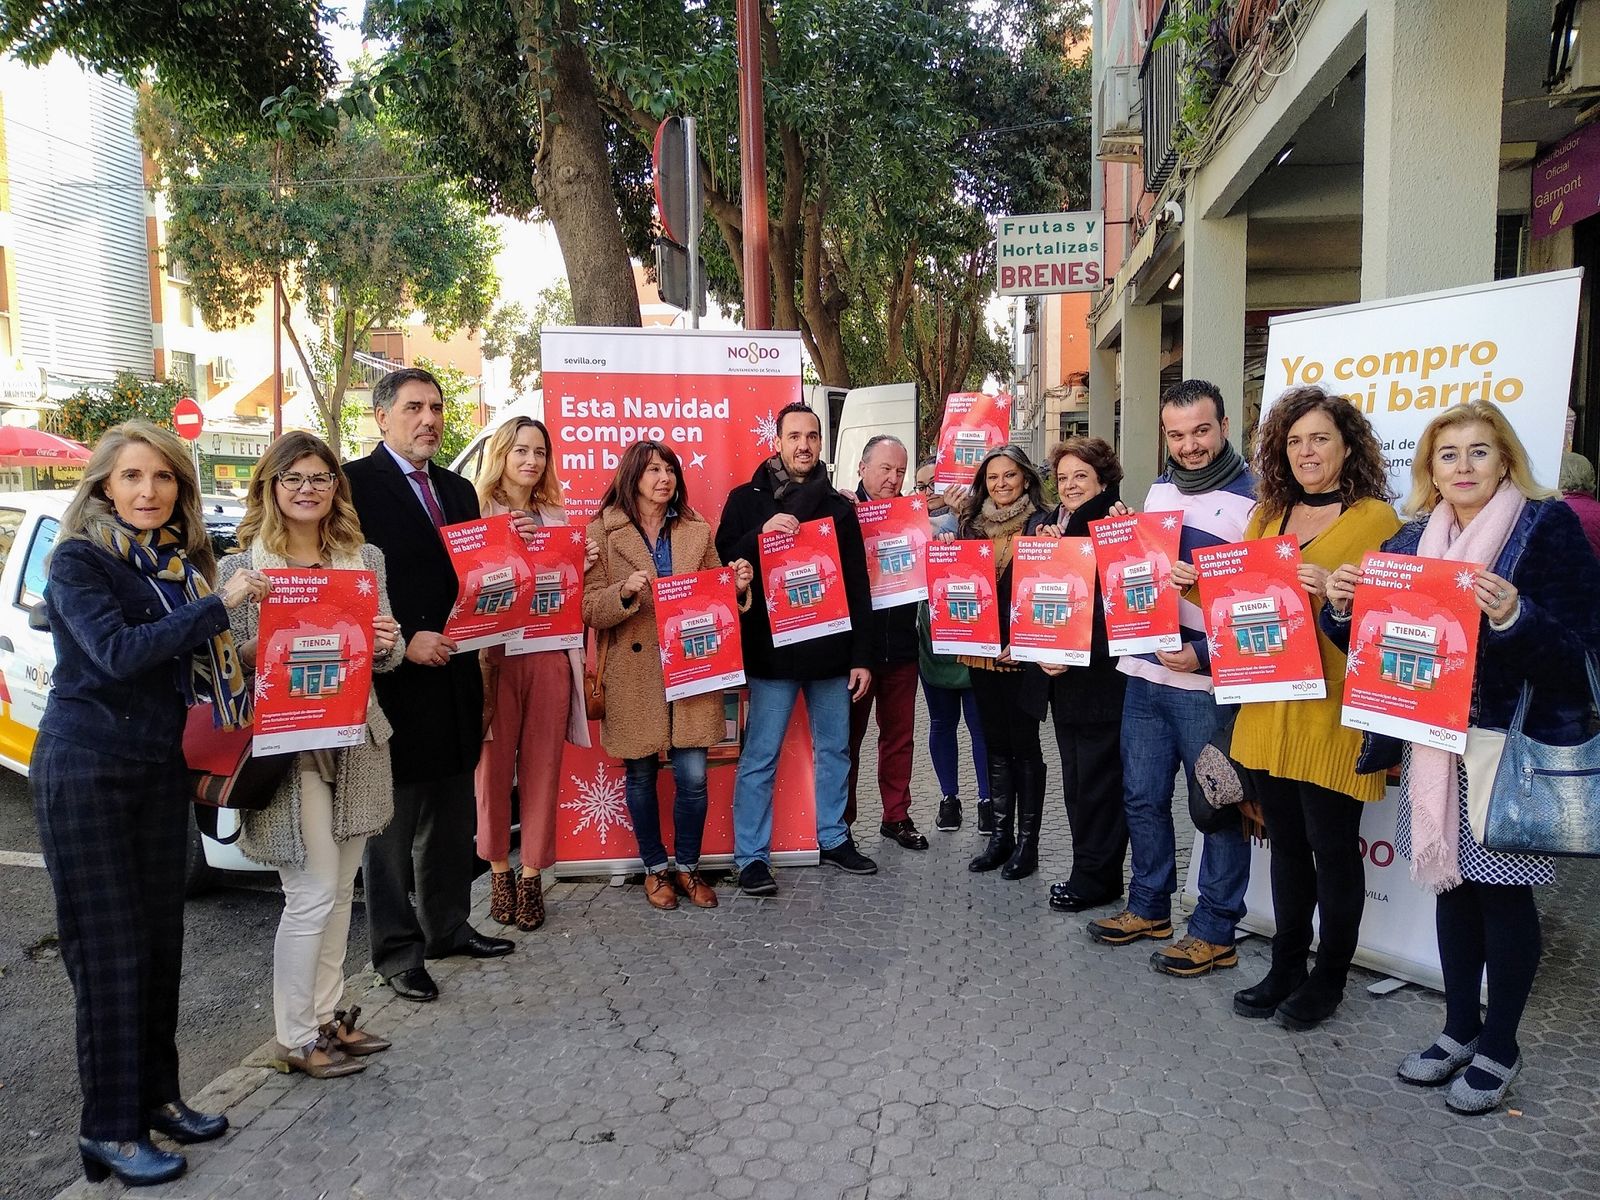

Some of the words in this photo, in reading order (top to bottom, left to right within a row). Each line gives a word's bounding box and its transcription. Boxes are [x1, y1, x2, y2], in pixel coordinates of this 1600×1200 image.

[1546, 160, 1570, 180] Oficial
[1004, 221, 1075, 236] Frutas
[1086, 221, 1096, 234] y
[1003, 242, 1099, 257] Hortalizas
[1001, 262, 1099, 288] BRENES
[564, 357, 606, 366] sevilla.org
[1281, 356, 1324, 385] Yo
[1334, 340, 1498, 380] compro
[1388, 372, 1524, 412] barrio
[561, 396, 615, 418] Esta
[623, 397, 729, 418] Navidad
[561, 425, 665, 447] compro
[672, 426, 703, 442] en
[1398, 439, 1415, 450] de
[562, 449, 594, 469] mi
[870, 503, 892, 511] Navidad
[858, 512, 879, 520] compro
[1095, 524, 1111, 533] Esta
[1112, 518, 1138, 529] Navidad
[448, 530, 461, 539] Esta
[462, 524, 488, 535] Navidad
[1096, 530, 1124, 538] compro
[450, 536, 474, 546] compro
[764, 540, 785, 549] compro
[1108, 535, 1129, 544] barrio
[461, 543, 481, 552] barrio
[772, 545, 790, 553] barrio
[1198, 554, 1215, 562] Esta
[1216, 548, 1248, 560] Navidad
[1200, 561, 1230, 570] compro
[1368, 558, 1385, 567] Esta
[1386, 560, 1424, 572] Navidad
[791, 568, 811, 576] TIENDA
[1213, 568, 1236, 576] barrio
[1365, 568, 1398, 578] compro
[291, 576, 328, 584] Navidad
[488, 573, 508, 582] TIENDA
[672, 578, 698, 586] Navidad
[1376, 578, 1403, 589] barrio
[658, 586, 682, 595] compro
[668, 592, 687, 600] barrio
[1240, 602, 1268, 612] TIENDA
[687, 618, 708, 626] TIENDA
[1395, 626, 1427, 638] TIENDA
[1366, 890, 1389, 902] VILLA
